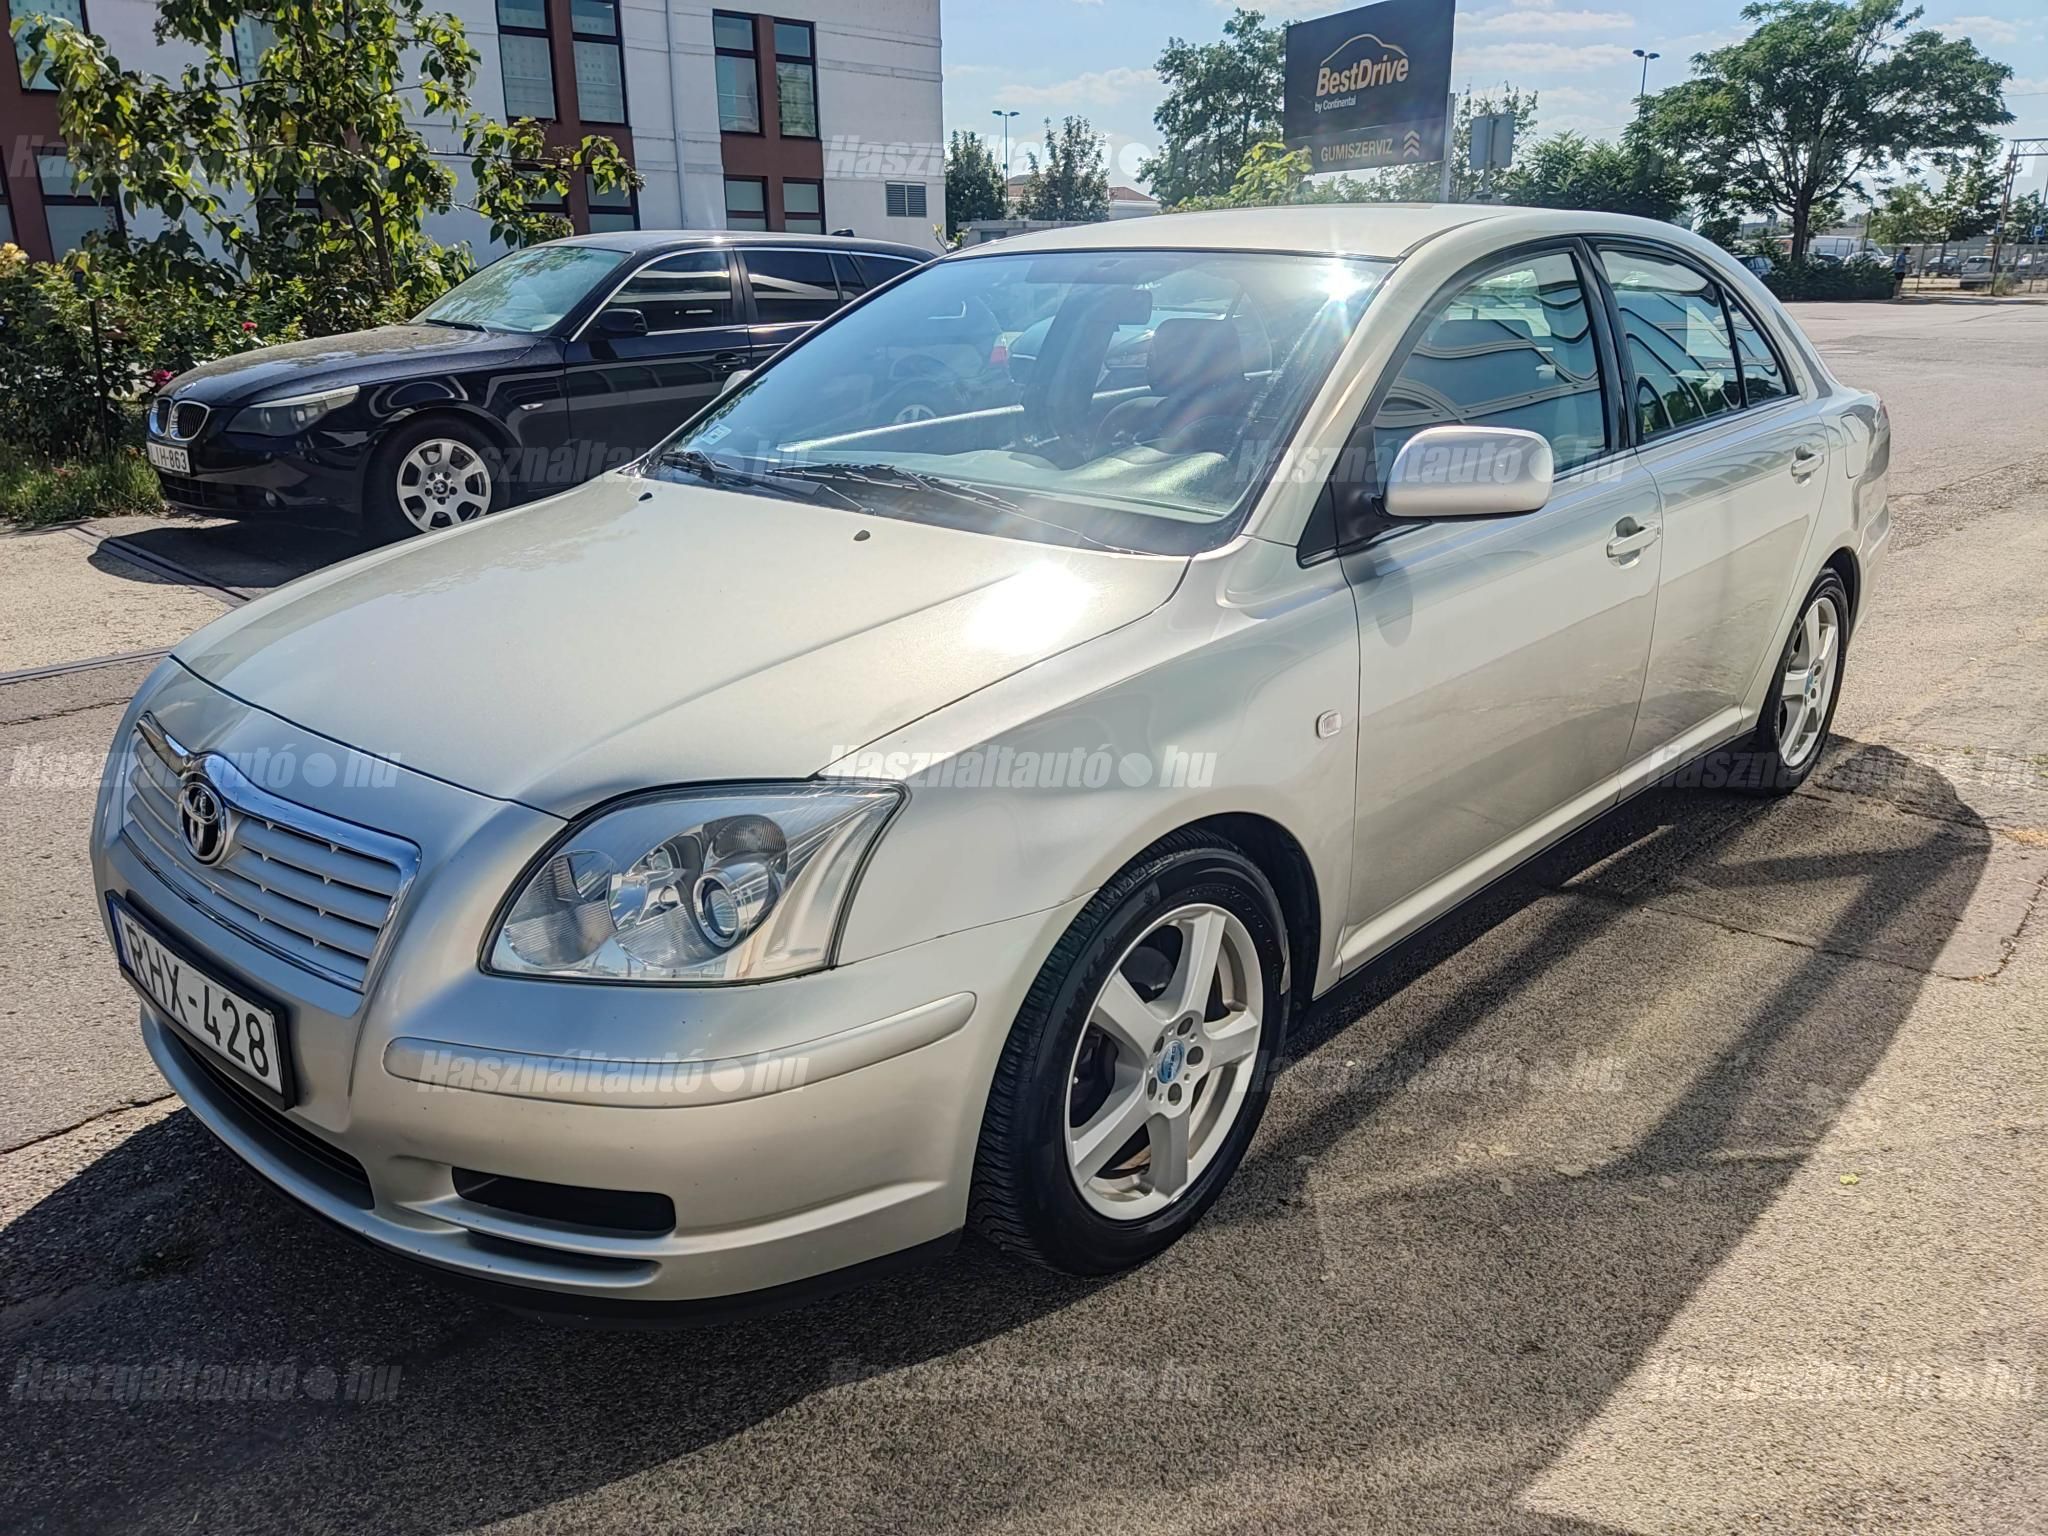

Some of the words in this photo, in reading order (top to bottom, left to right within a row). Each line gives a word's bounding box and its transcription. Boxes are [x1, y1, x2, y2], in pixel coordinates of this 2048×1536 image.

[1316, 55, 1409, 97] BestDrive
[1315, 102, 1322, 113] by
[1323, 95, 1357, 111] Continental
[1321, 138, 1393, 162] GUMISZERVIZ
[126, 923, 269, 1077] RHX-428
